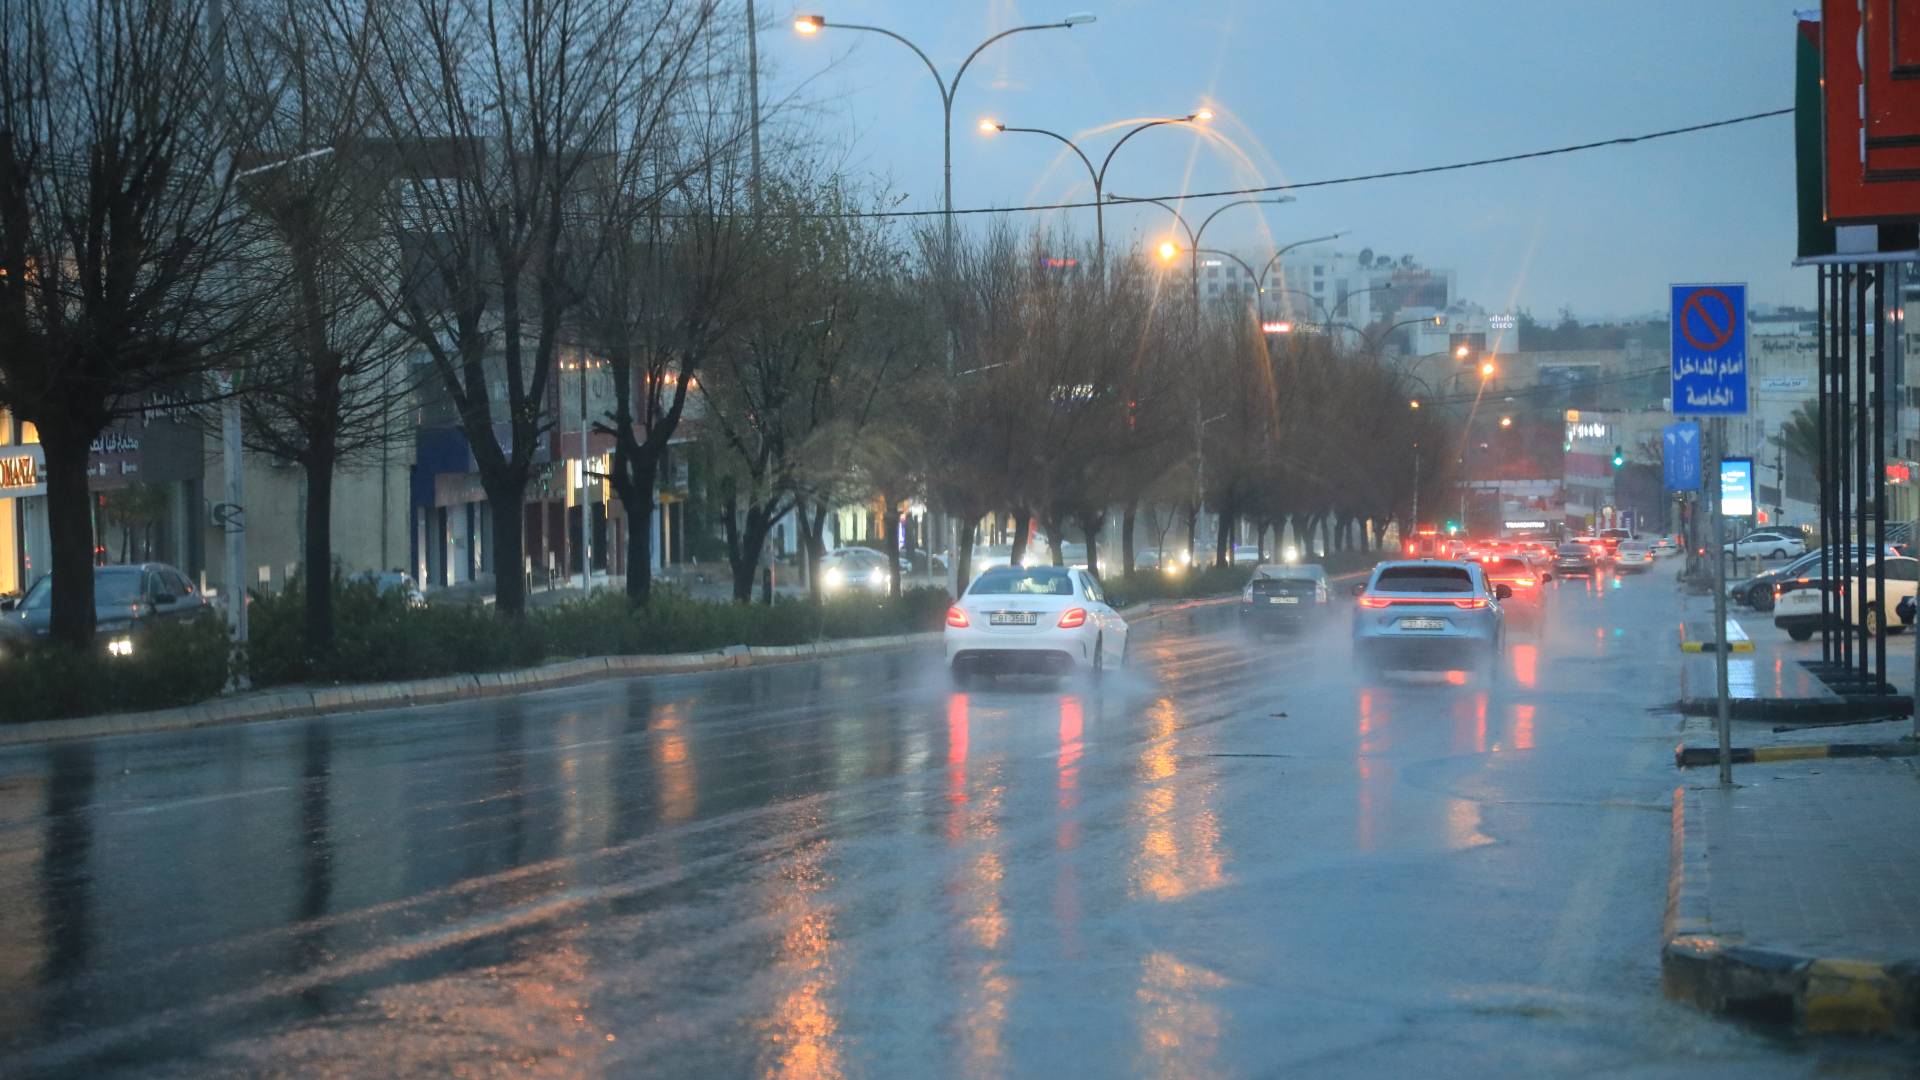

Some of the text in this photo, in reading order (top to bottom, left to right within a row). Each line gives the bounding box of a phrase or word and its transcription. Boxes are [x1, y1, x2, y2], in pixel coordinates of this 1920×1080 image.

[1674, 352, 1744, 383] أمام المداخل
[1685, 384, 1734, 406] الخاصة
